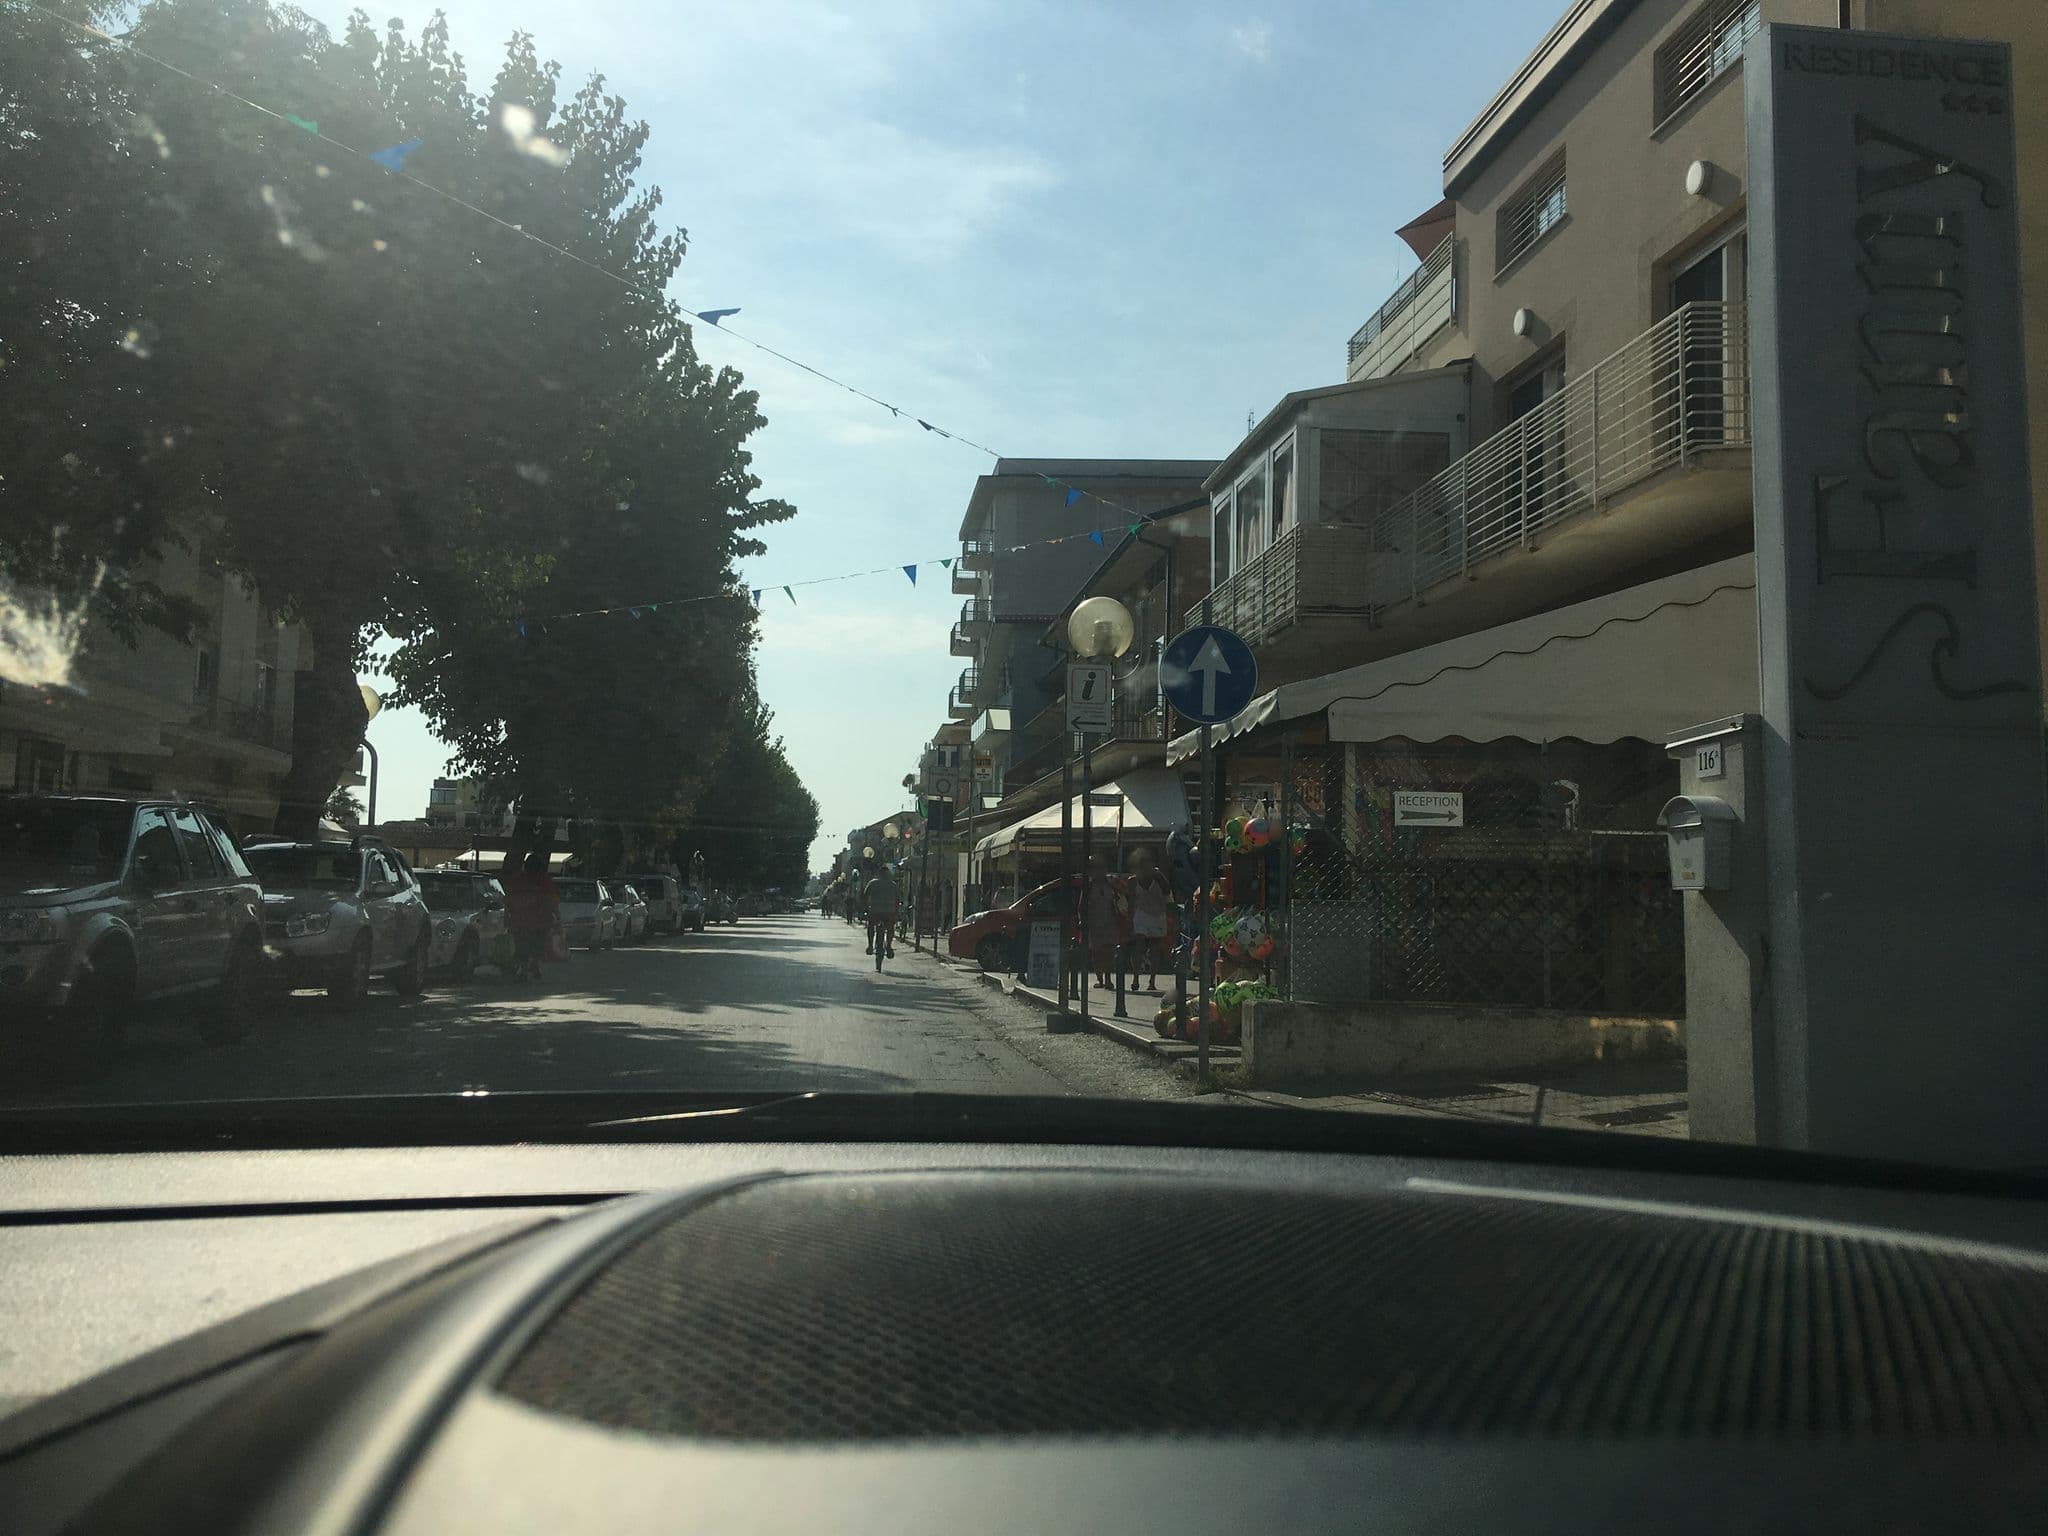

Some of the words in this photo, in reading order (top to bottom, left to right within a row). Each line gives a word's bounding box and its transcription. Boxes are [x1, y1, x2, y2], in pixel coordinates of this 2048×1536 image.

[1784, 41, 2003, 87] RESIDENCE
[1813, 113, 2005, 589] Fanny
[1399, 796, 1459, 807] RECEPTION
